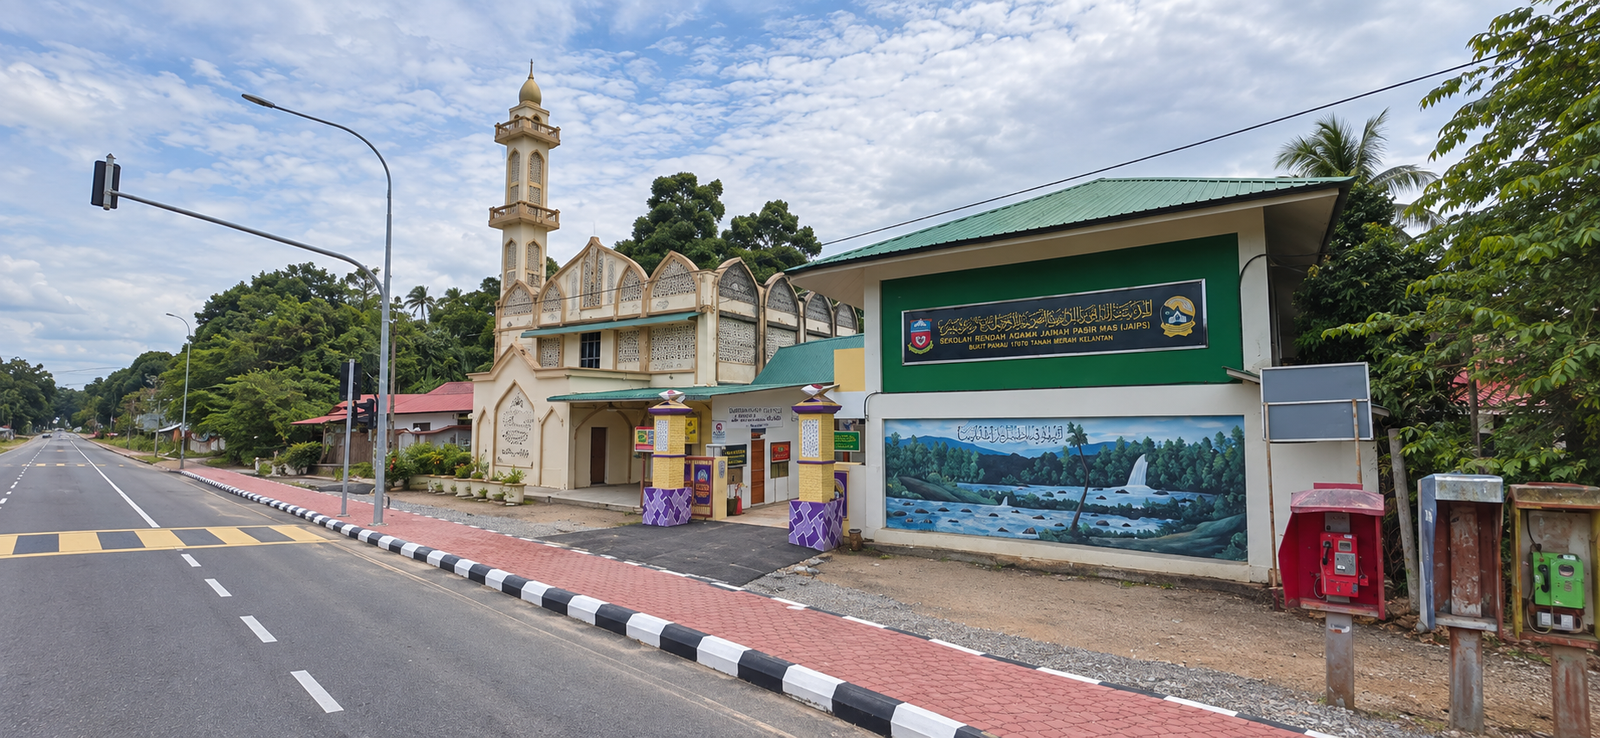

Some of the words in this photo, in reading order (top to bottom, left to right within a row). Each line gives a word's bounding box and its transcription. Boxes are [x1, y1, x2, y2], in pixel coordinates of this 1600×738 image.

[940, 336, 972, 345] SEKOLAH
[975, 333, 1006, 342] RENDAH
[1072, 325, 1097, 334] PASIR
[1099, 324, 1118, 332] MAS
[1120, 321, 1150, 331] (JAIPS)
[1079, 335, 1114, 343] KELANTAN
